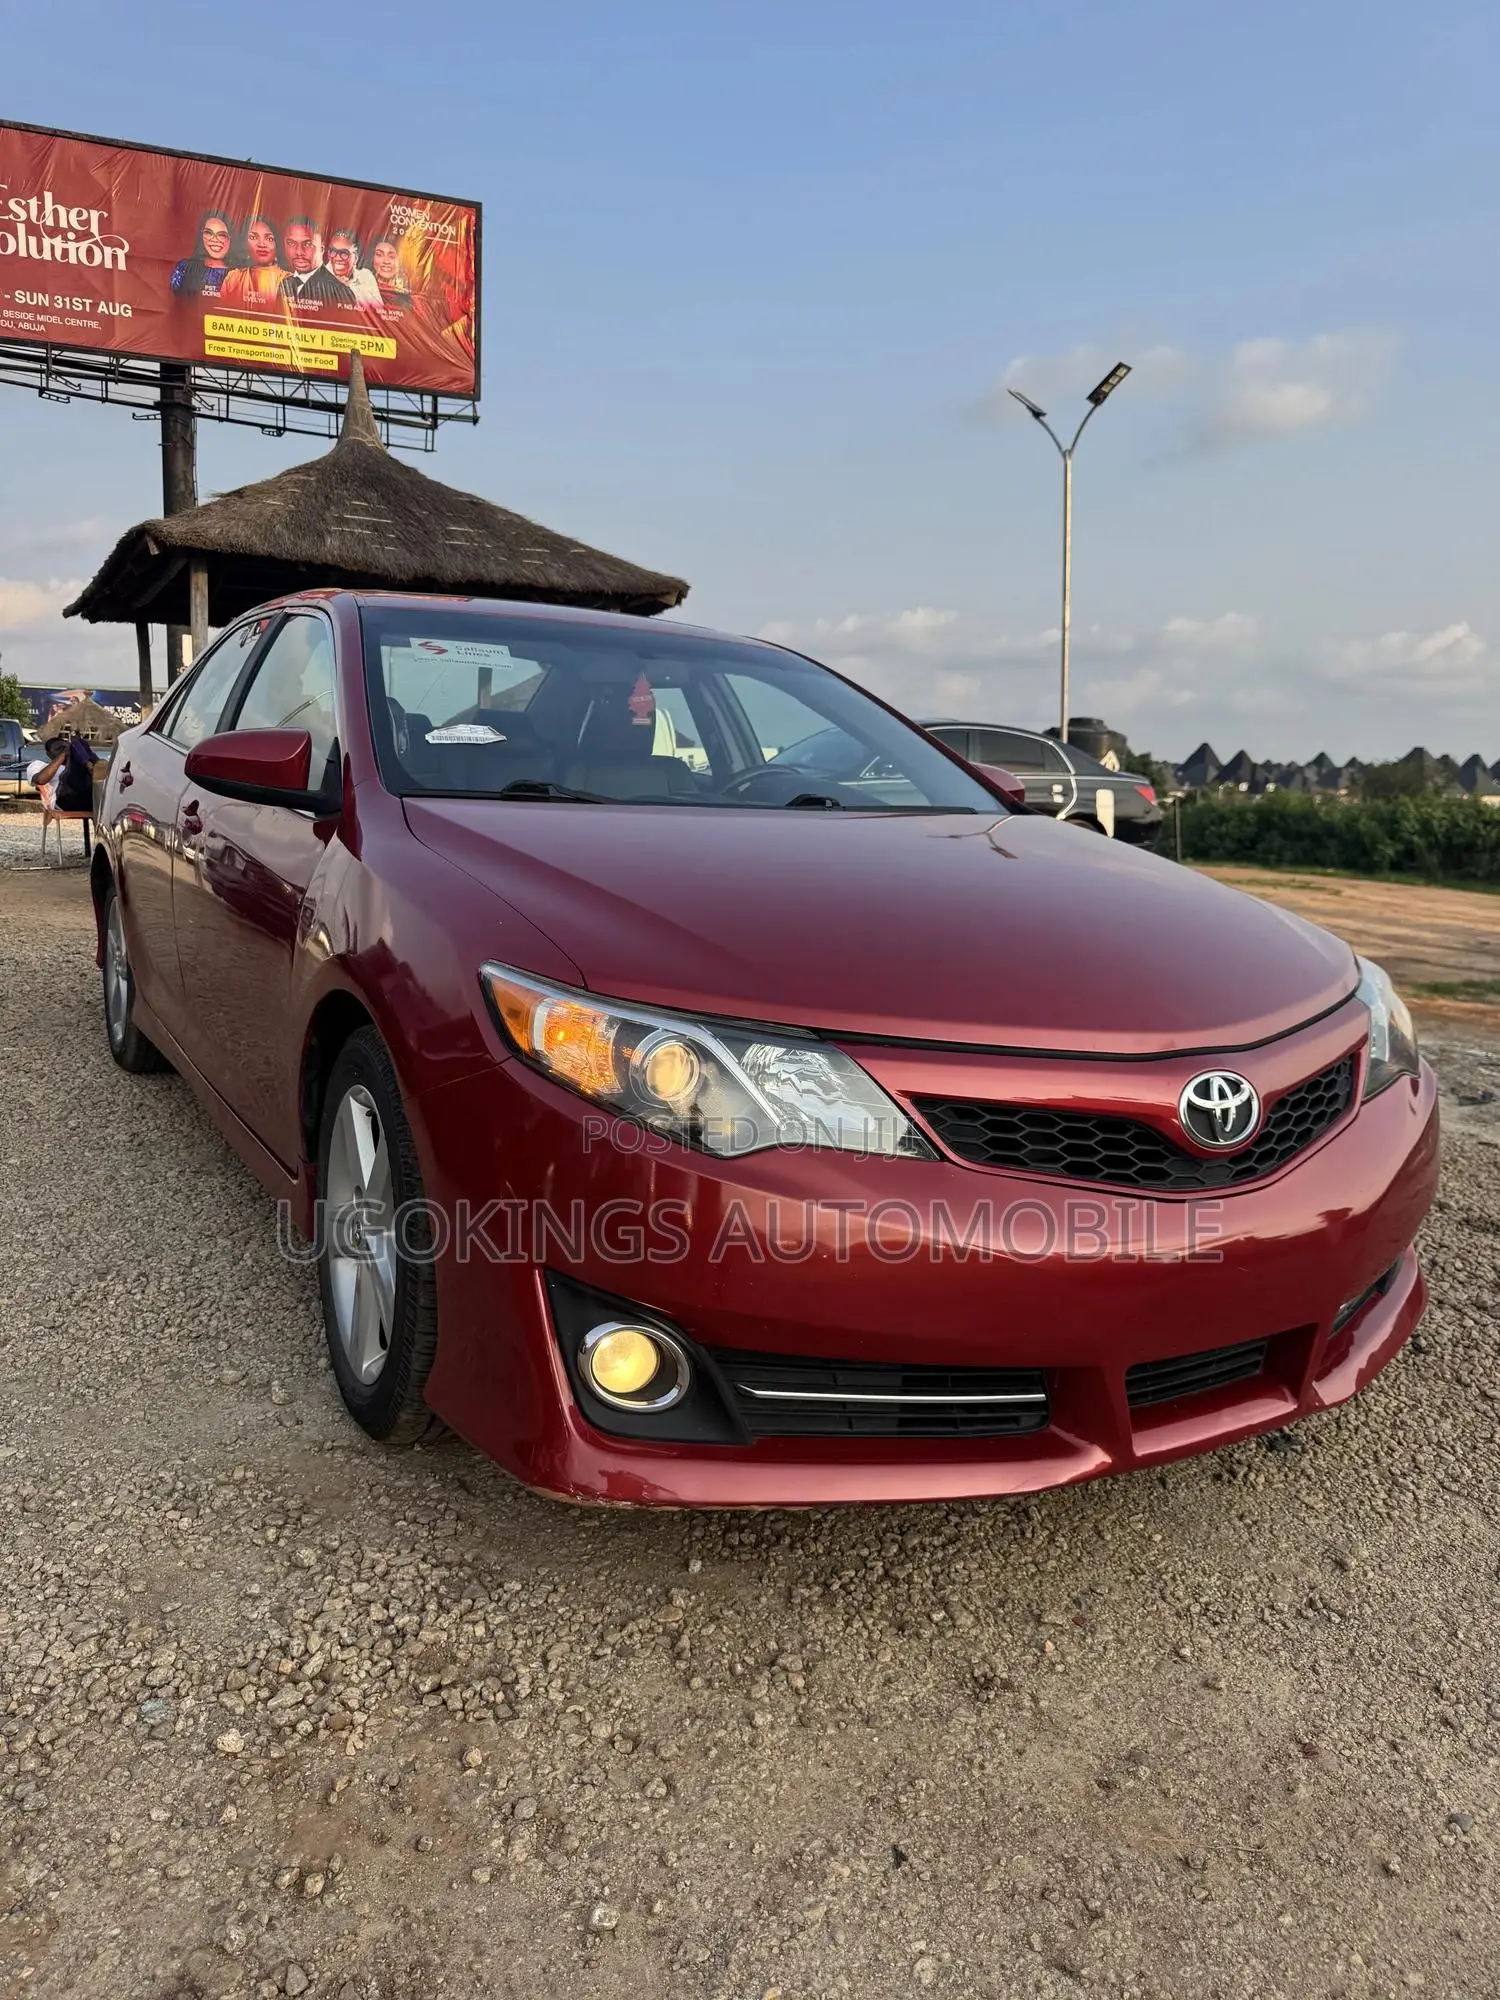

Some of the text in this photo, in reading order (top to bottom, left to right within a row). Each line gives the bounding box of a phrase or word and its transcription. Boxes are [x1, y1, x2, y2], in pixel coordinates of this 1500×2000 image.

[390, 204, 430, 221] WOMEN
[390, 214, 456, 236] CONVENTION
[15, 290, 49, 307] SUN
[54, 295, 93, 312] 31ST
[97, 301, 132, 317] AUG
[3, 309, 35, 320] BESIDE
[37, 314, 63, 324] MIDEL
[18, 322, 46, 332] ABUJA
[212, 321, 234, 333] 8AM
[237, 324, 260, 335] AND
[262, 328, 284, 339] 5PM
[331, 336, 358, 346] Opening
[331, 341, 355, 350] Sessio
[360, 340, 385, 353] 5PM
[208, 344, 285, 360] Free Transportation
[314, 357, 334, 366] Food
